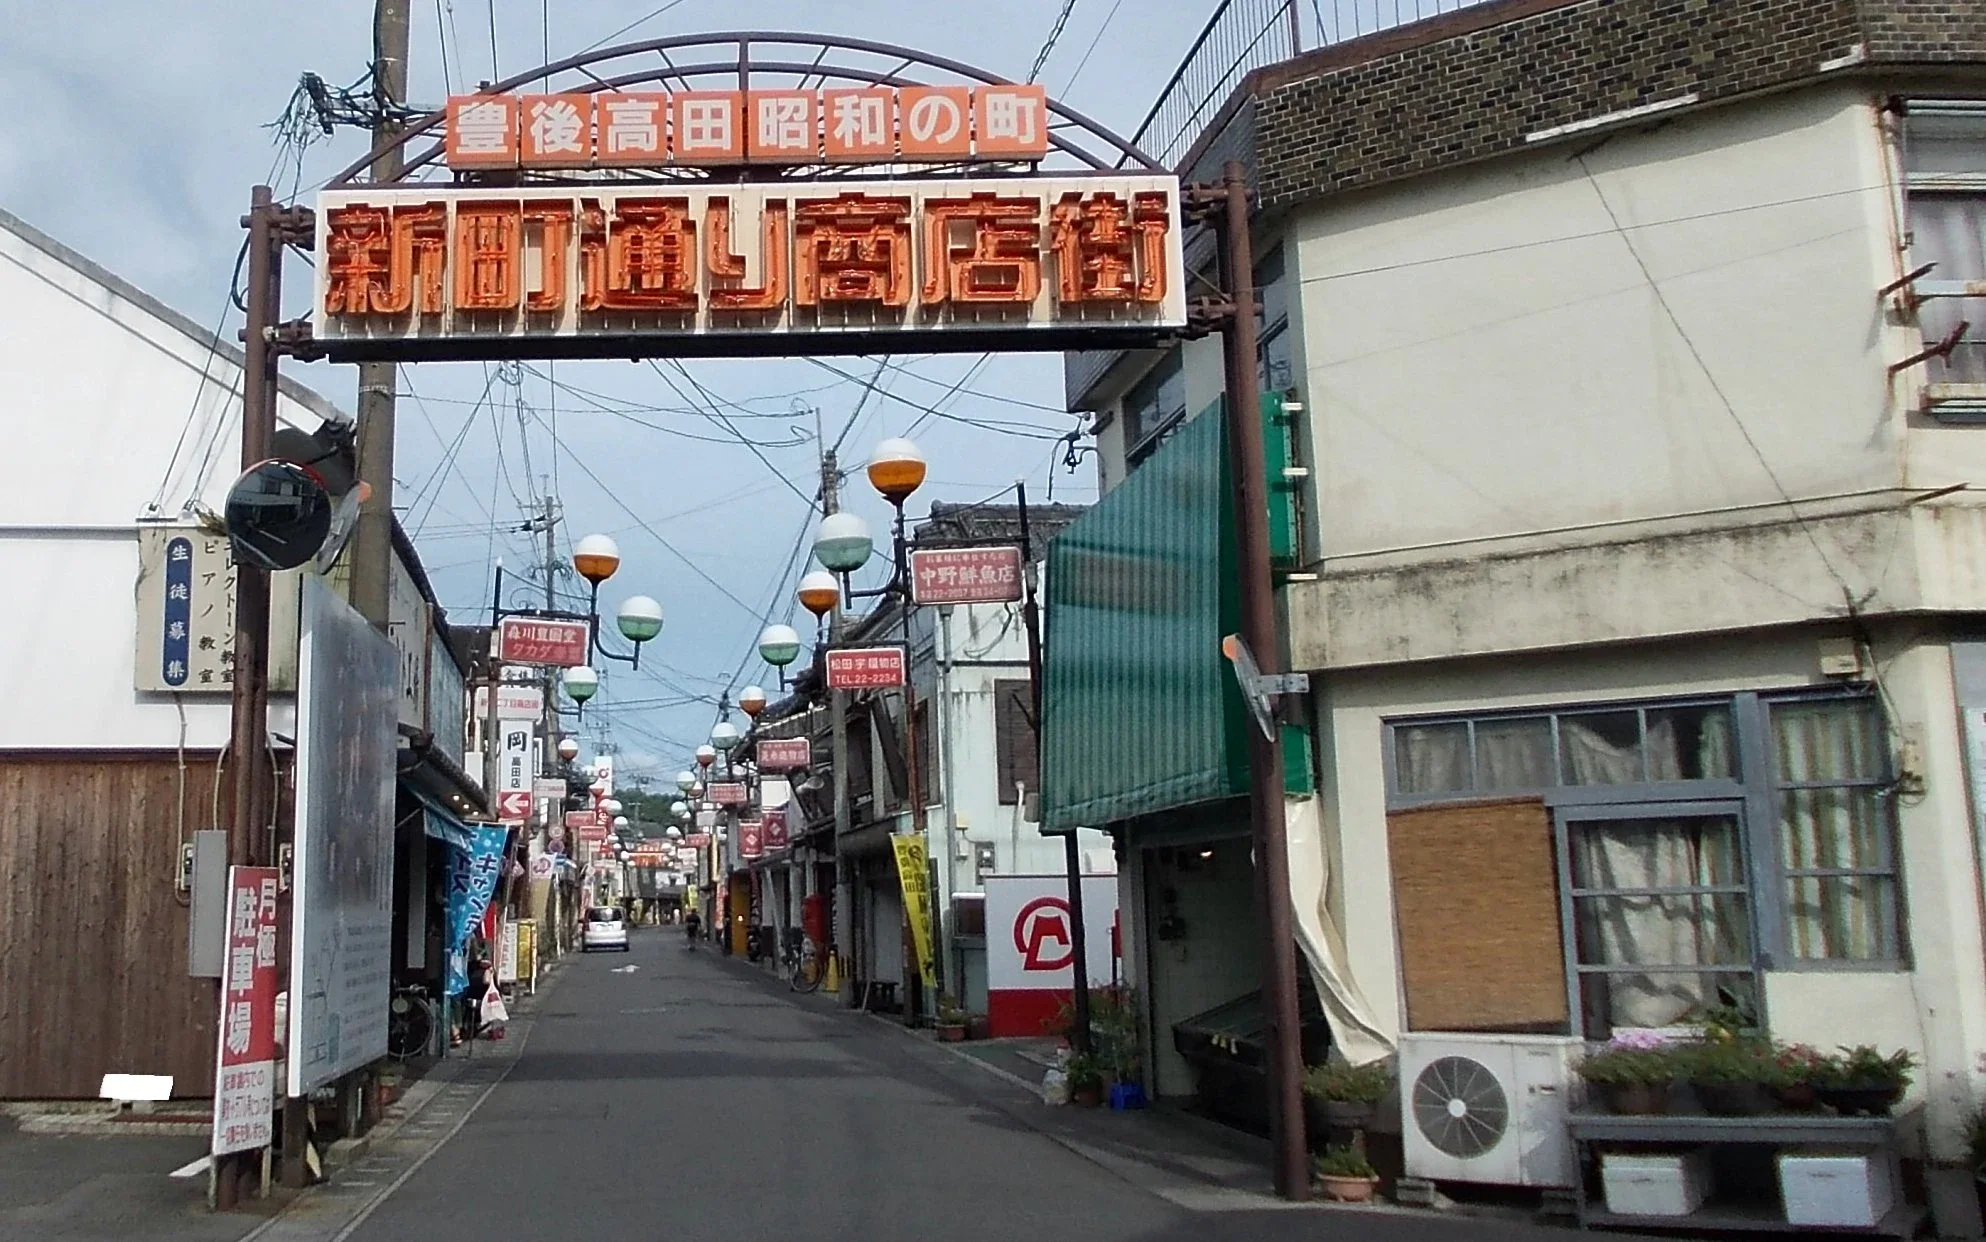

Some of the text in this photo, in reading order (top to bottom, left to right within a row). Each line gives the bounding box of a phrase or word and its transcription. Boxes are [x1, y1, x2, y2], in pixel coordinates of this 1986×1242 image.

[455, 93, 1037, 155] 豊後高田昭和の町
[325, 191, 1168, 316] 新町通り商店街
[167, 545, 189, 678] 生徒募集
[198, 541, 217, 683] ピアノ教室
[919, 564, 1015, 587] 中野鮮魚店
[227, 887, 258, 1055] 駐車場
